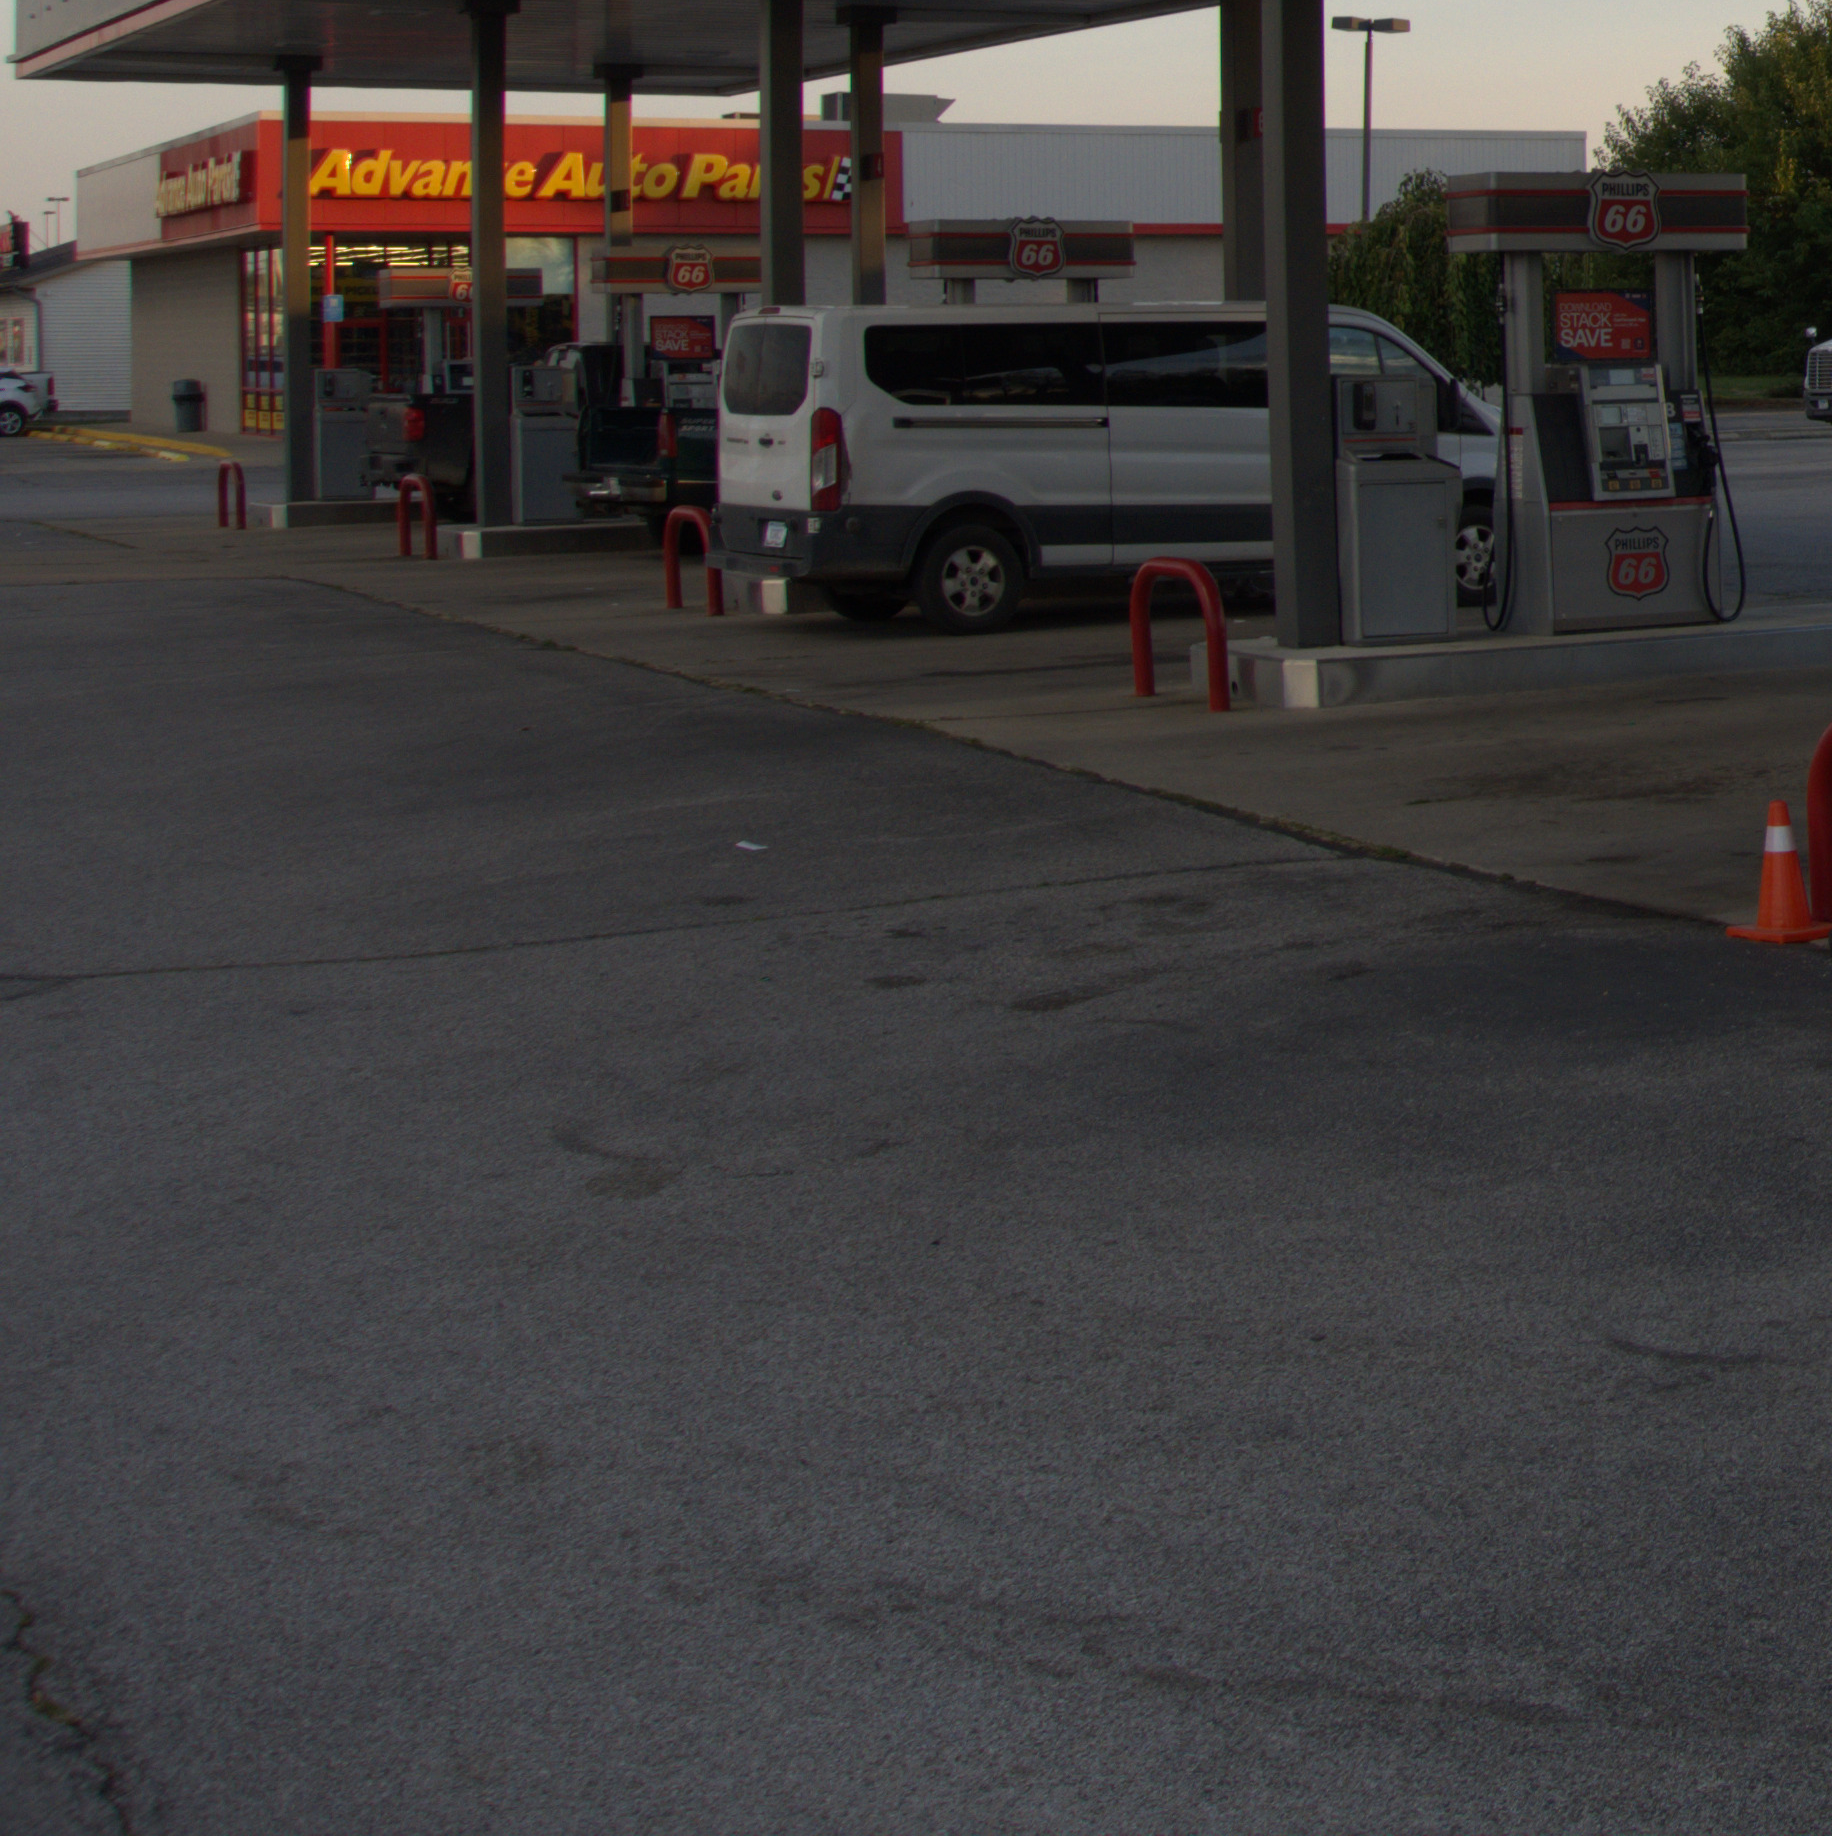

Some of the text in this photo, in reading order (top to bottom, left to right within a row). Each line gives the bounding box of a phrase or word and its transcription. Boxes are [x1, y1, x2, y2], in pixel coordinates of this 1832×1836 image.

[310, 149, 538, 197] Advane
[1602, 183, 1649, 196] PHILLIPS
[1605, 204, 1647, 233] 66
[1021, 244, 1055, 266] 66
[678, 265, 706, 283] 66
[1560, 313, 1612, 328] STACK
[656, 340, 689, 351] SAVE
[1561, 328, 1613, 348] SAVE
[1615, 537, 1659, 550] PHILLIPS
[1619, 557, 1657, 584] 66
